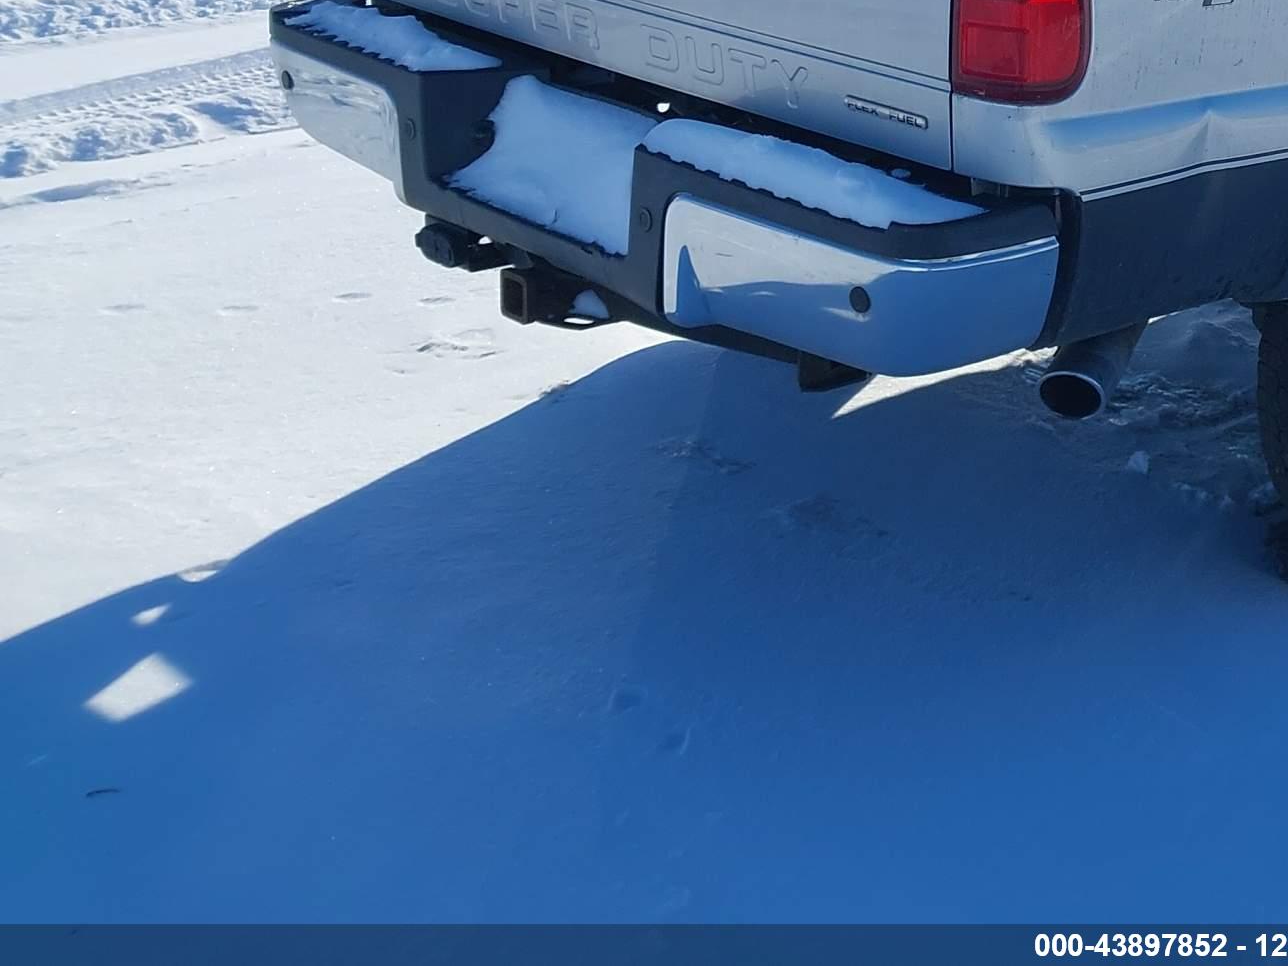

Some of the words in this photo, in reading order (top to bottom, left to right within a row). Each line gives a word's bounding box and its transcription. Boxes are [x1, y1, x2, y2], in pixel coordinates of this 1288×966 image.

[640, 22, 809, 109] DUTY
[847, 101, 880, 117] FLEX
[889, 113, 923, 130] FUEL
